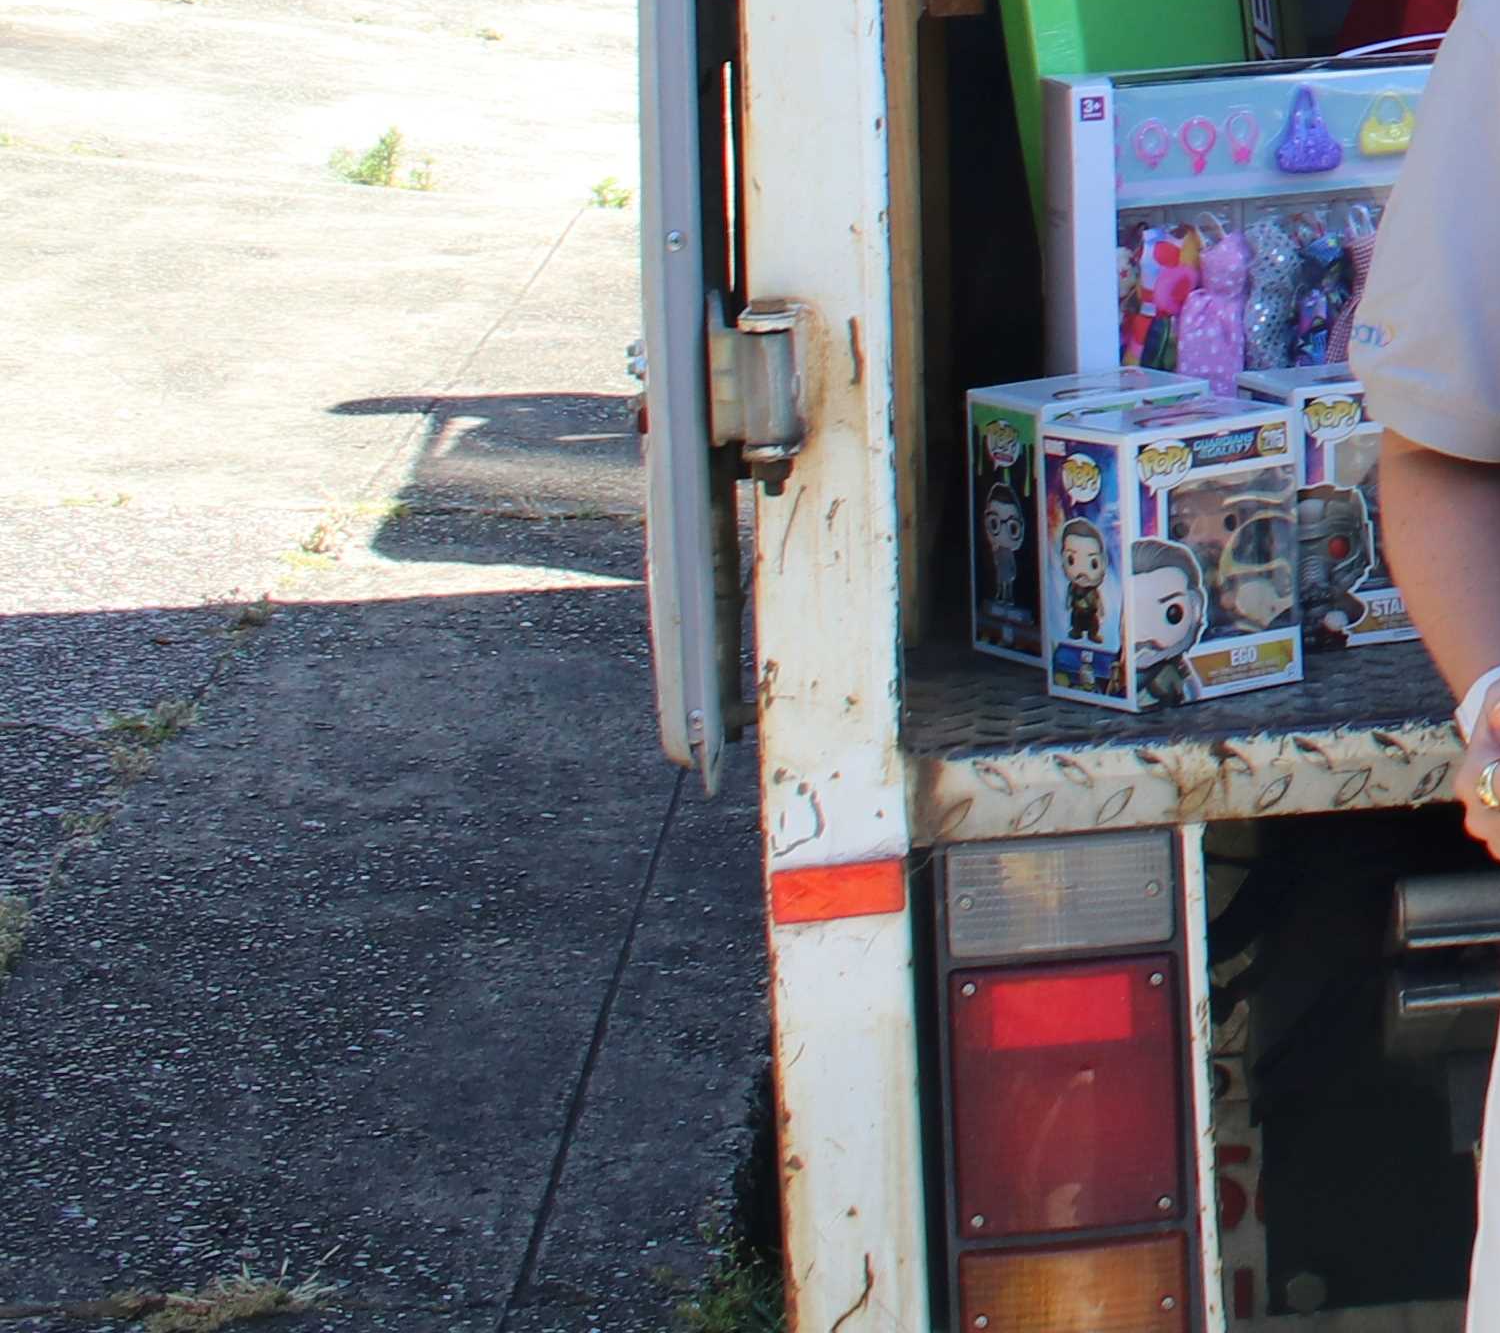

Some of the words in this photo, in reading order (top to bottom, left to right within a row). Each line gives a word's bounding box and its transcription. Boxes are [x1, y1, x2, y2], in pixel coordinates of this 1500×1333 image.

[1083, 99, 1101, 113] 3+
[1304, 399, 1361, 432] POP!
[1137, 441, 1192, 480] POP!
